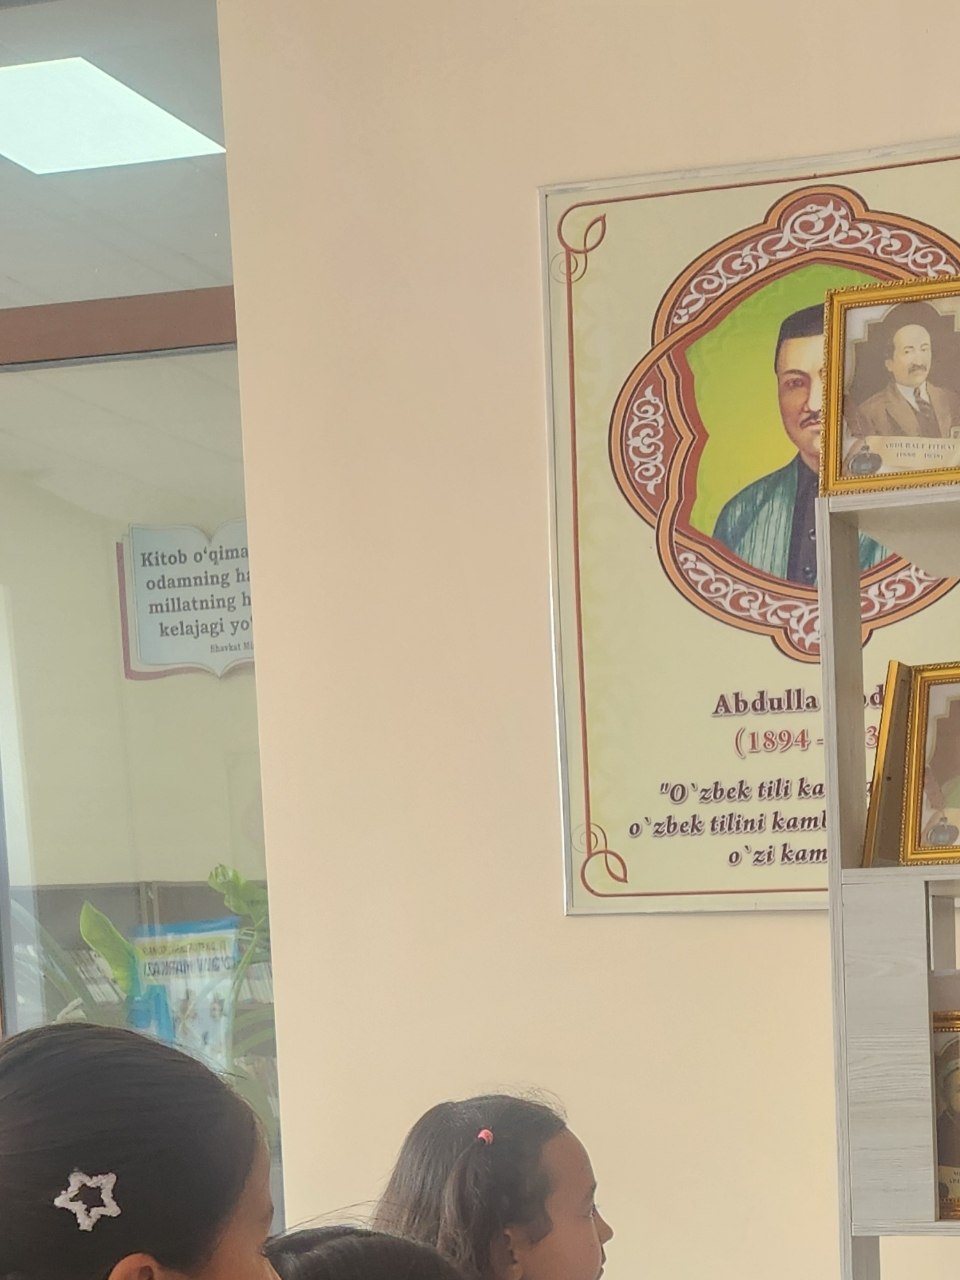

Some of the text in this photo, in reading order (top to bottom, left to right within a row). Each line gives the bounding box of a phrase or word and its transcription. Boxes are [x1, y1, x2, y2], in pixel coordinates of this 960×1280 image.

[141, 545, 248, 567] Kitob o‘qima
[146, 570, 230, 590] odamning
[148, 594, 236, 614] millatning
[160, 618, 225, 639] kelajagi
[712, 688, 818, 716] Abdulla
[735, 727, 810, 758] (1894
[758, 778, 791, 799] tili
[797, 776, 825, 797] ka
[710, 812, 765, 833] tilini
[771, 810, 827, 832] kam
[780, 842, 827, 863] kam
